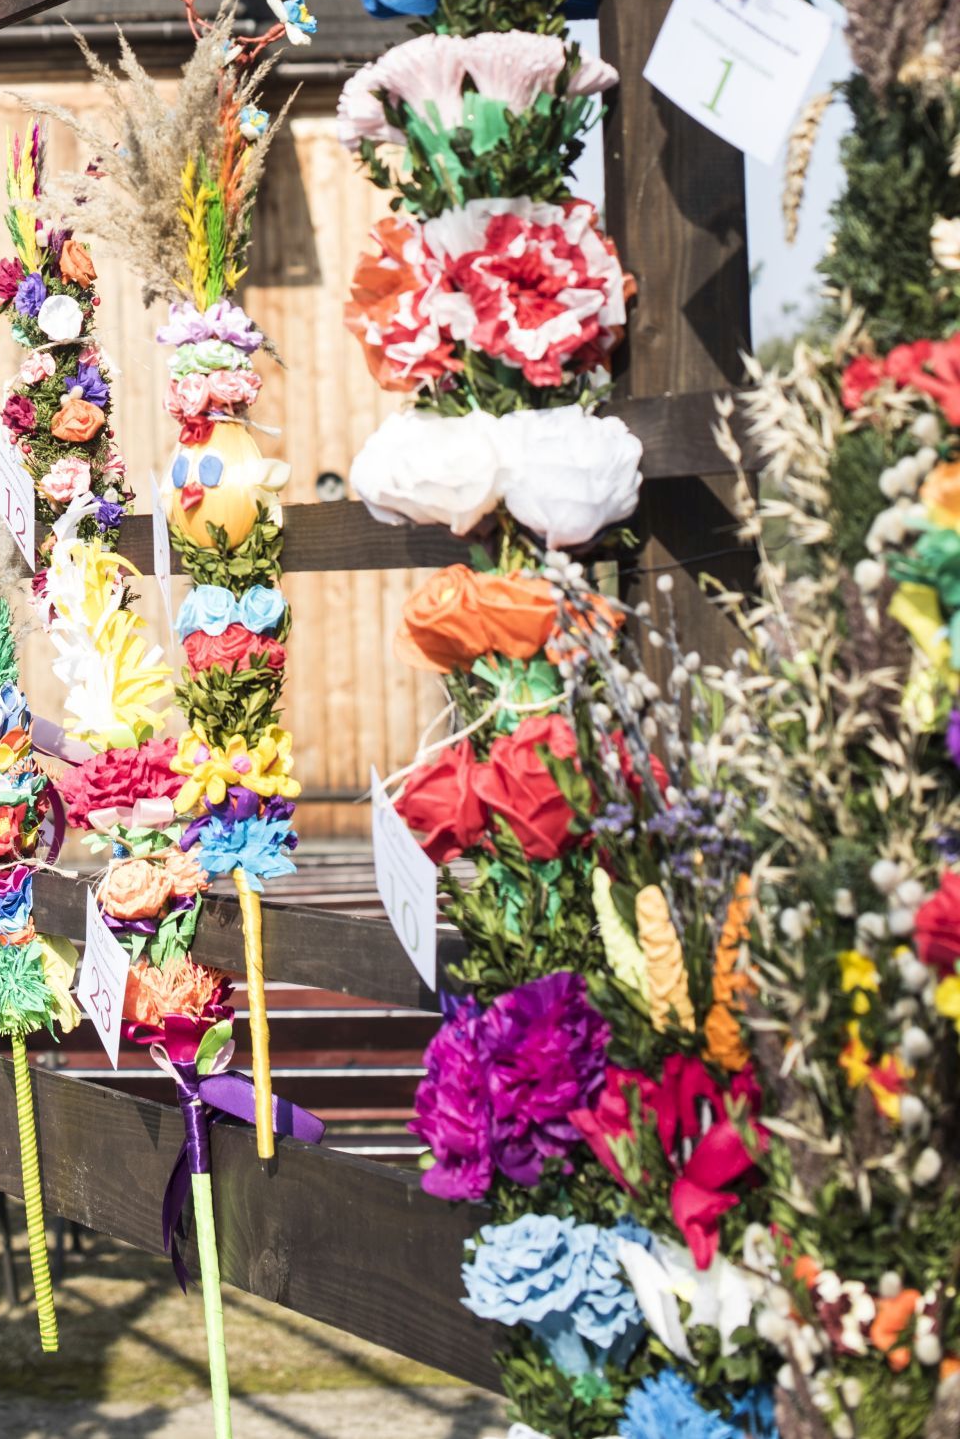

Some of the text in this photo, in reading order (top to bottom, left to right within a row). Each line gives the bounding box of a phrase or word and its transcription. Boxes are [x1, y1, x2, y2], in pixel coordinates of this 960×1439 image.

[701, 57, 733, 117] 1
[5, 487, 26, 551] 12
[388, 872, 419, 952] 10
[90, 966, 111, 1033] 23
